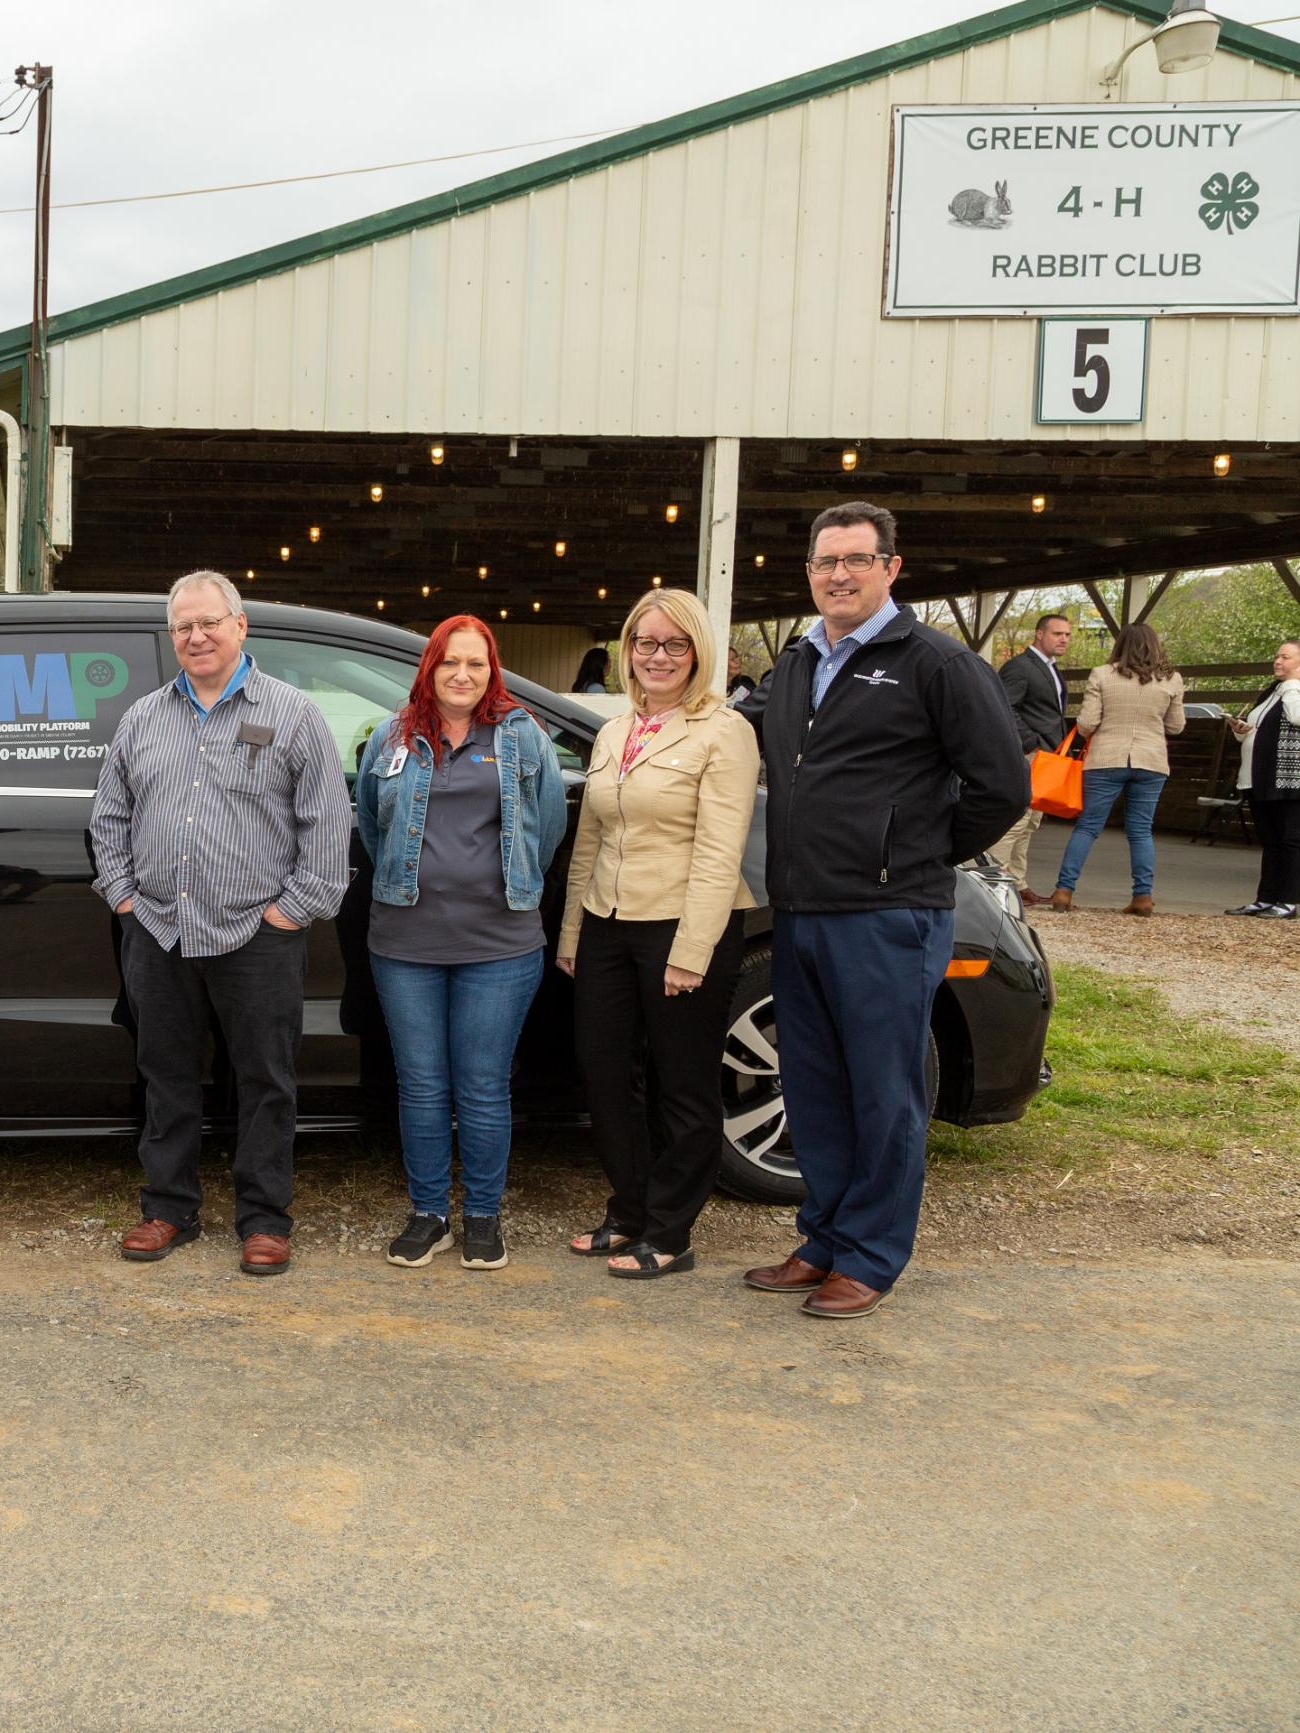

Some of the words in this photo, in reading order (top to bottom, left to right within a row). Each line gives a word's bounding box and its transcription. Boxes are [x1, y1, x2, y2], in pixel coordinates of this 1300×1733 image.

[966, 125, 1100, 151] GREENE
[1107, 123, 1243, 149] COUNTY
[991, 254, 1109, 279] RABBIT
[1114, 253, 1202, 278] CLUB
[1071, 328, 1111, 414] 5
[39, 721, 91, 731] PLATFORM
[63, 743, 110, 760] (7267)
